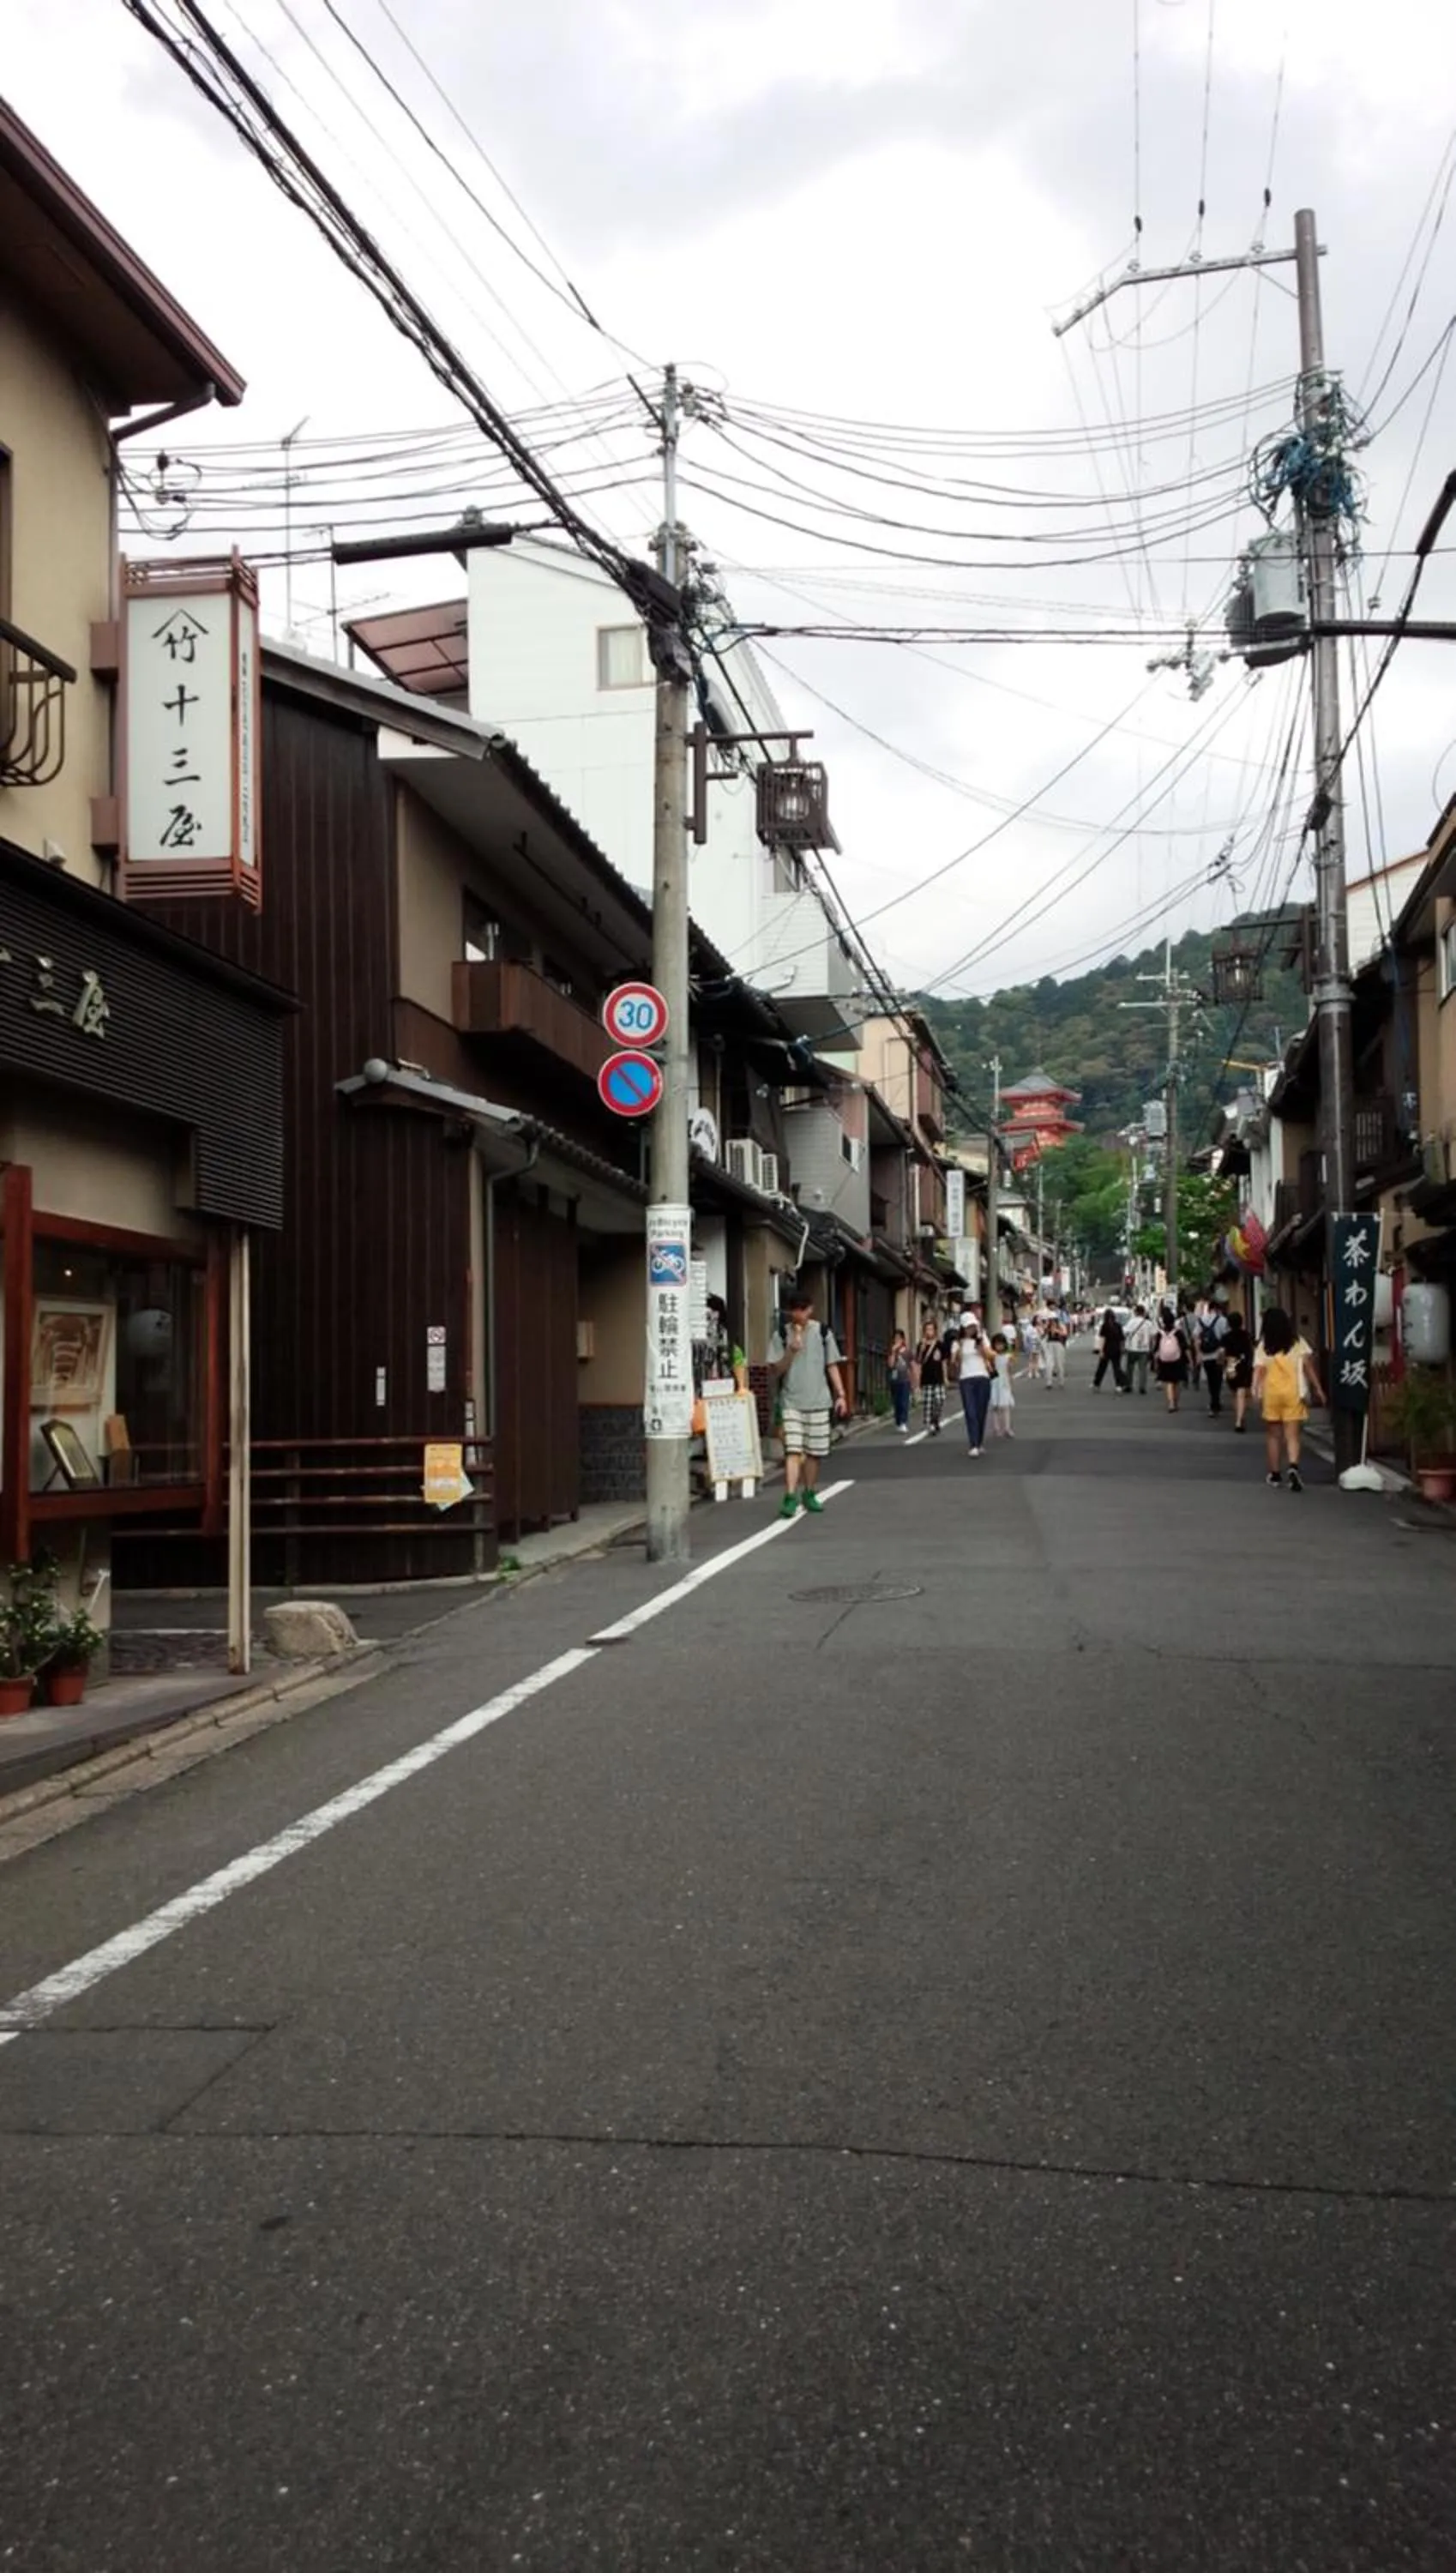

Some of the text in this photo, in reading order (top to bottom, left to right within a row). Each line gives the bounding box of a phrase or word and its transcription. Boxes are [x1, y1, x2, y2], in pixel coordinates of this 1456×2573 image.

[159, 624, 203, 847] 竹十三屋
[0, 947, 110, 1039] 三屋
[618, 1001, 653, 1029] 30
[659, 1293, 678, 1379] 駐輪禁止
[1340, 1228, 1370, 1388] 茶わん坂
